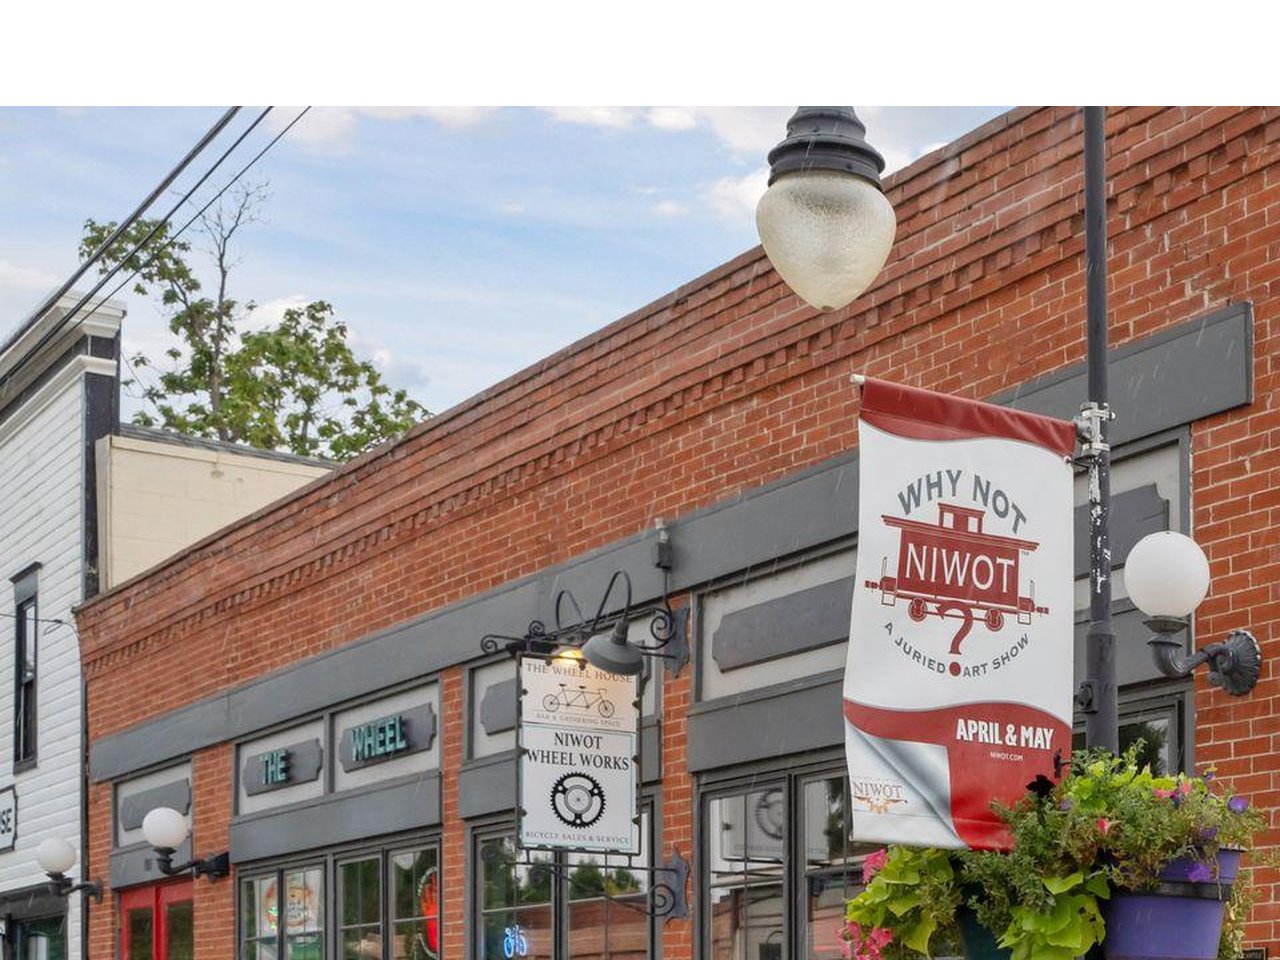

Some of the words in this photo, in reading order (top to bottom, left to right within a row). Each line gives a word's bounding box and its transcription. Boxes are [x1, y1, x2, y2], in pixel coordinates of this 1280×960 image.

[897, 469, 962, 515] WHY
[972, 474, 1027, 534] NOT
[905, 543, 1015, 593] NIWOT
[884, 622, 893, 636] A
[895, 636, 946, 674] JURIED
[962, 663, 989, 678] ART
[992, 633, 1029, 670] SHOW
[526, 663, 549, 674] THE
[552, 665, 592, 679] WHEEL
[595, 671, 633, 684] HOUSE
[559, 714, 600, 725] GATHERING
[600, 719, 621, 727] SPACE
[554, 732, 603, 750] NIWOT
[956, 718, 1002, 745] APRIL
[1005, 724, 1018, 746] &
[1021, 726, 1055, 750] MAY
[258, 747, 289, 785] THE
[351, 715, 406, 762] WHEEL
[527, 750, 577, 767] WHEEL
[581, 754, 630, 771] WORKS
[852, 781, 903, 799] NIWOT
[526, 831, 560, 840] BICYCLE
[562, 833, 586, 842] SALES
[596, 835, 629, 844] SERVICE
